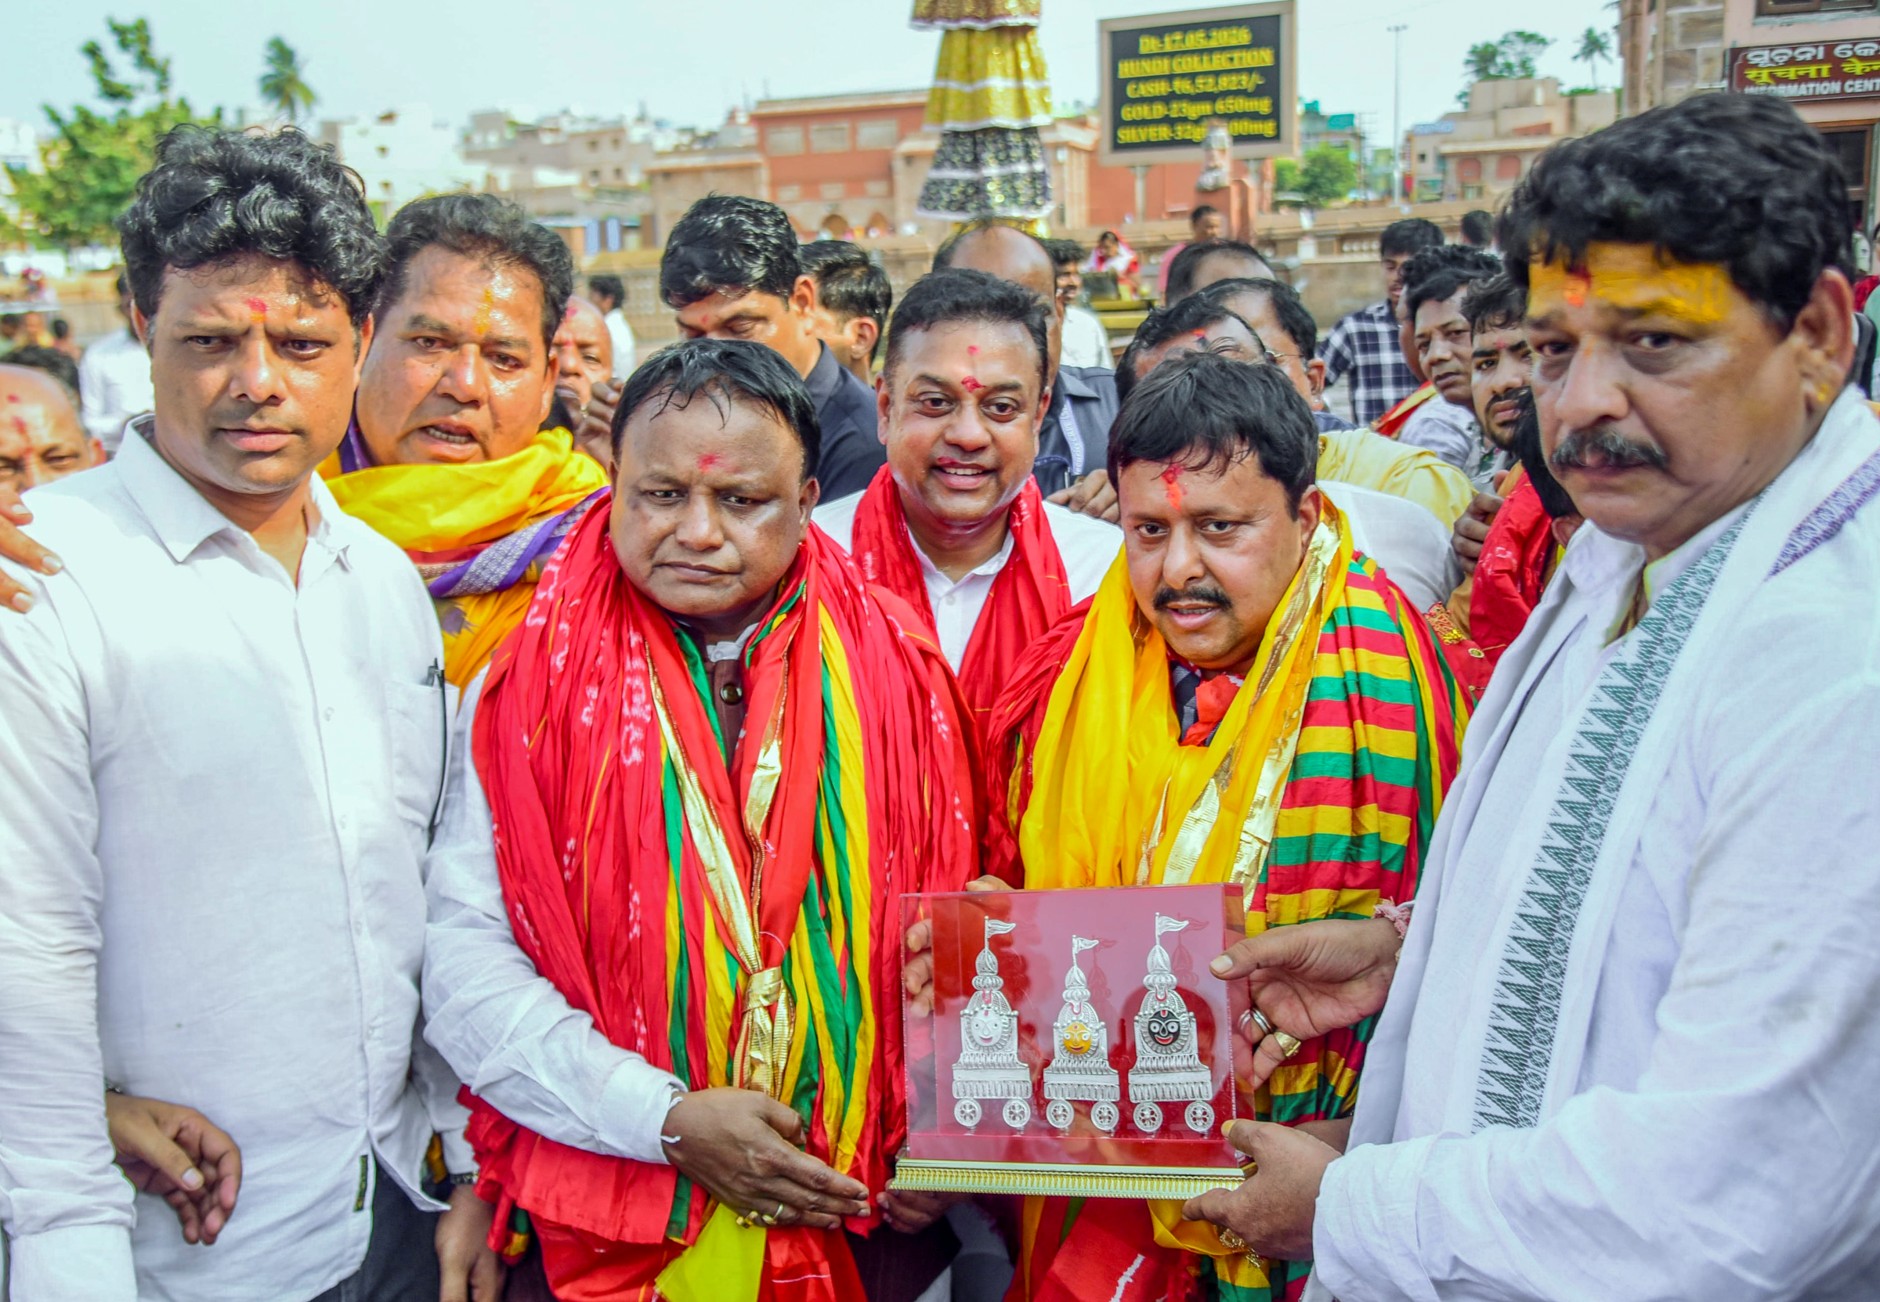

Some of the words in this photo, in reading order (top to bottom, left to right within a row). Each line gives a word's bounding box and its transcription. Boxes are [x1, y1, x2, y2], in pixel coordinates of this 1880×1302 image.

[1118, 56, 1171, 78] HUNDI
[1172, 47, 1275, 74] COLLECTION
[1744, 63, 1832, 86] सूचना
[1215, 95, 1273, 115] 650mg
[1117, 121, 1209, 143] SILVER-32g
